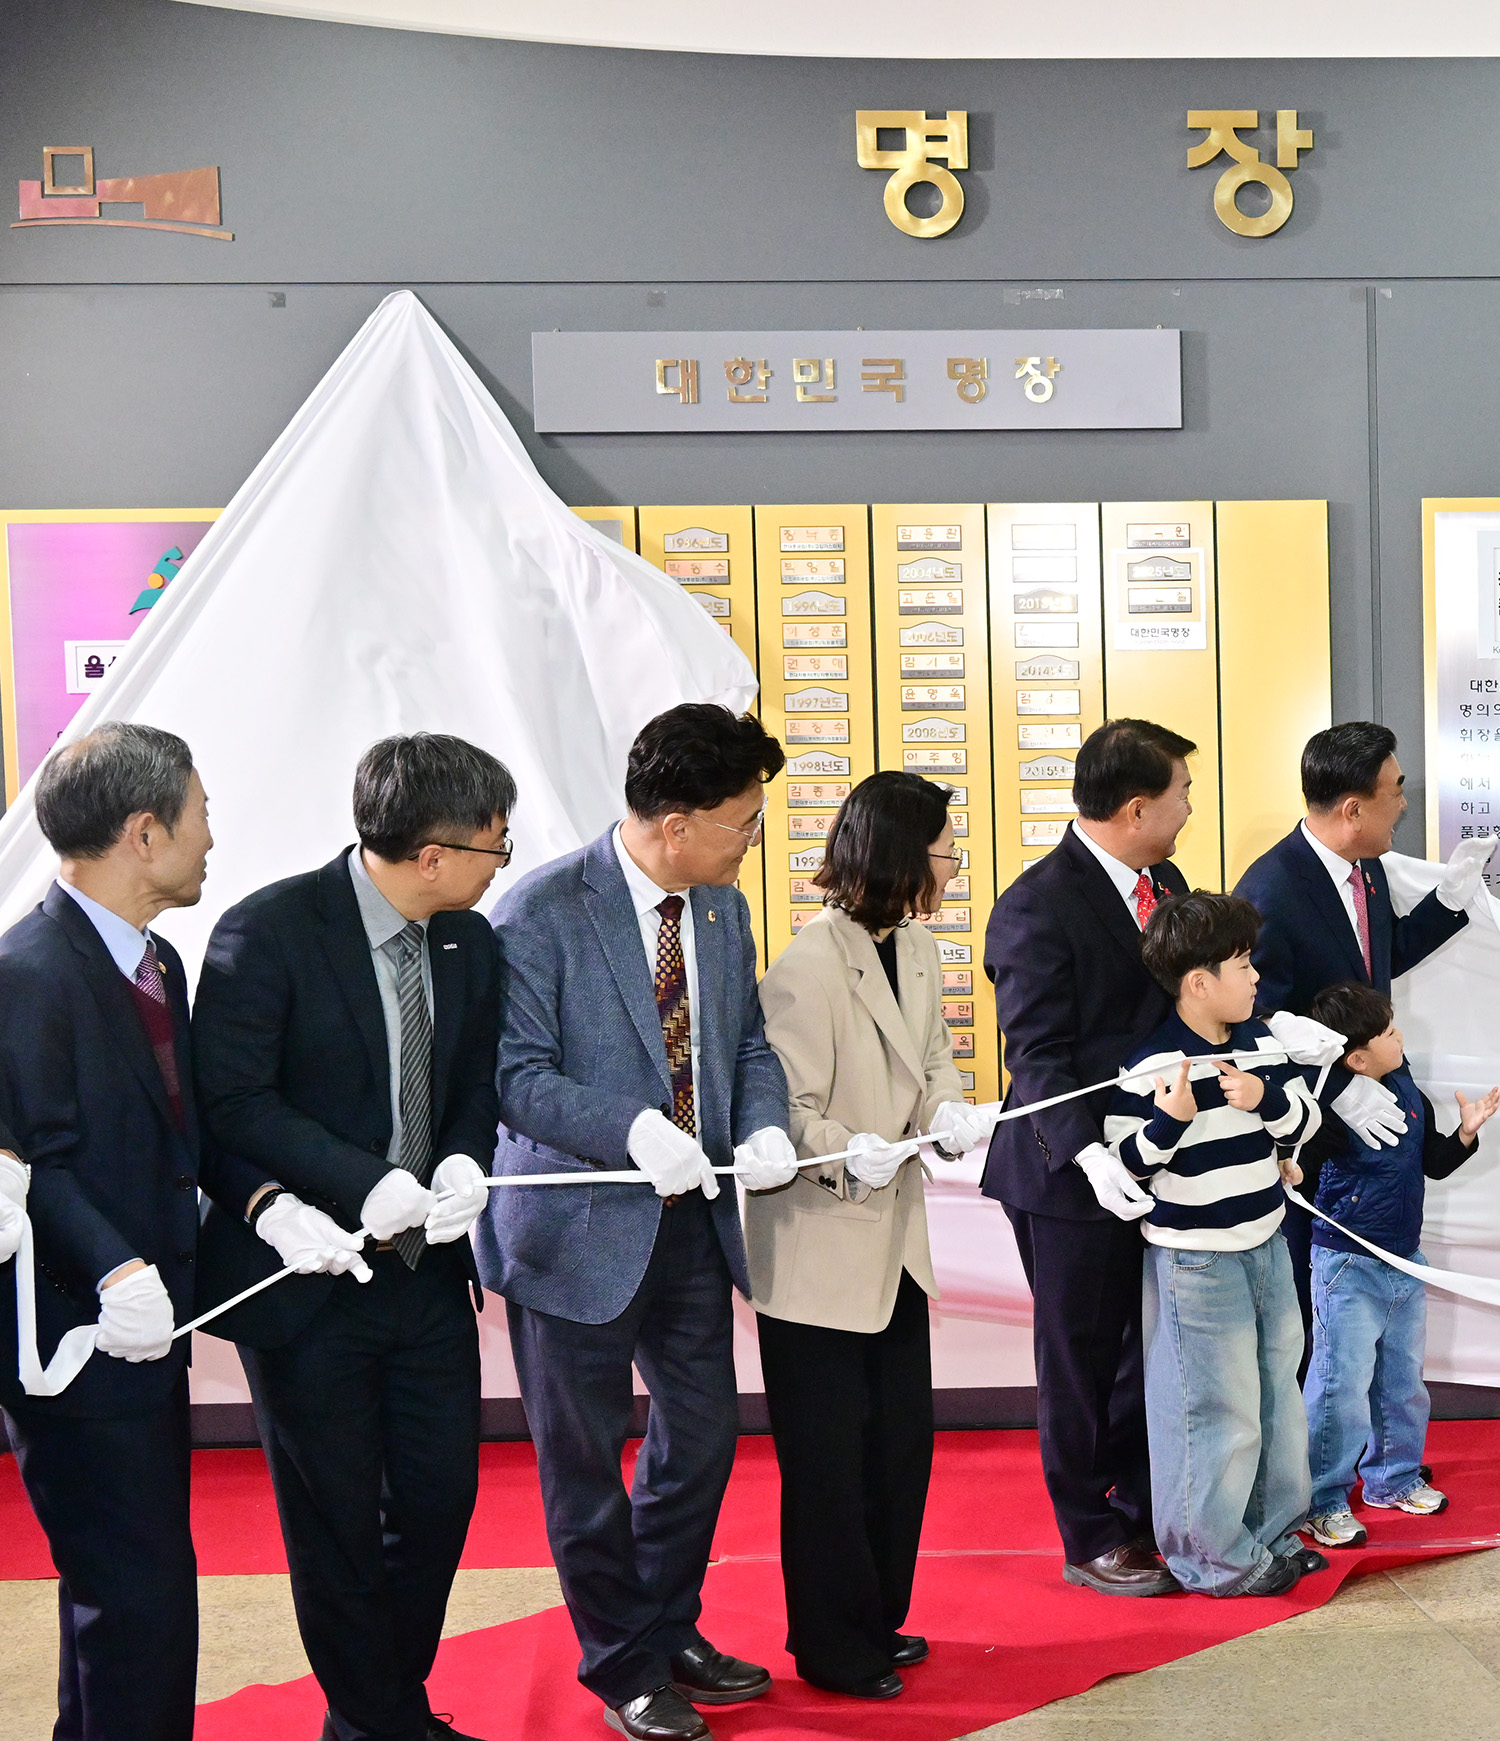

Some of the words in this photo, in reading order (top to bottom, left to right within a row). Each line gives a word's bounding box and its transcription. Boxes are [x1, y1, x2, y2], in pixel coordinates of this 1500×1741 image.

[655, 356, 906, 404] 대한민국
[947, 356, 1062, 404] 명장
[791, 697, 842, 708] 1997년도
[793, 761, 844, 772] 1998년도
[1460, 777, 1491, 790] 에서
[1460, 802, 1490, 814] 하고
